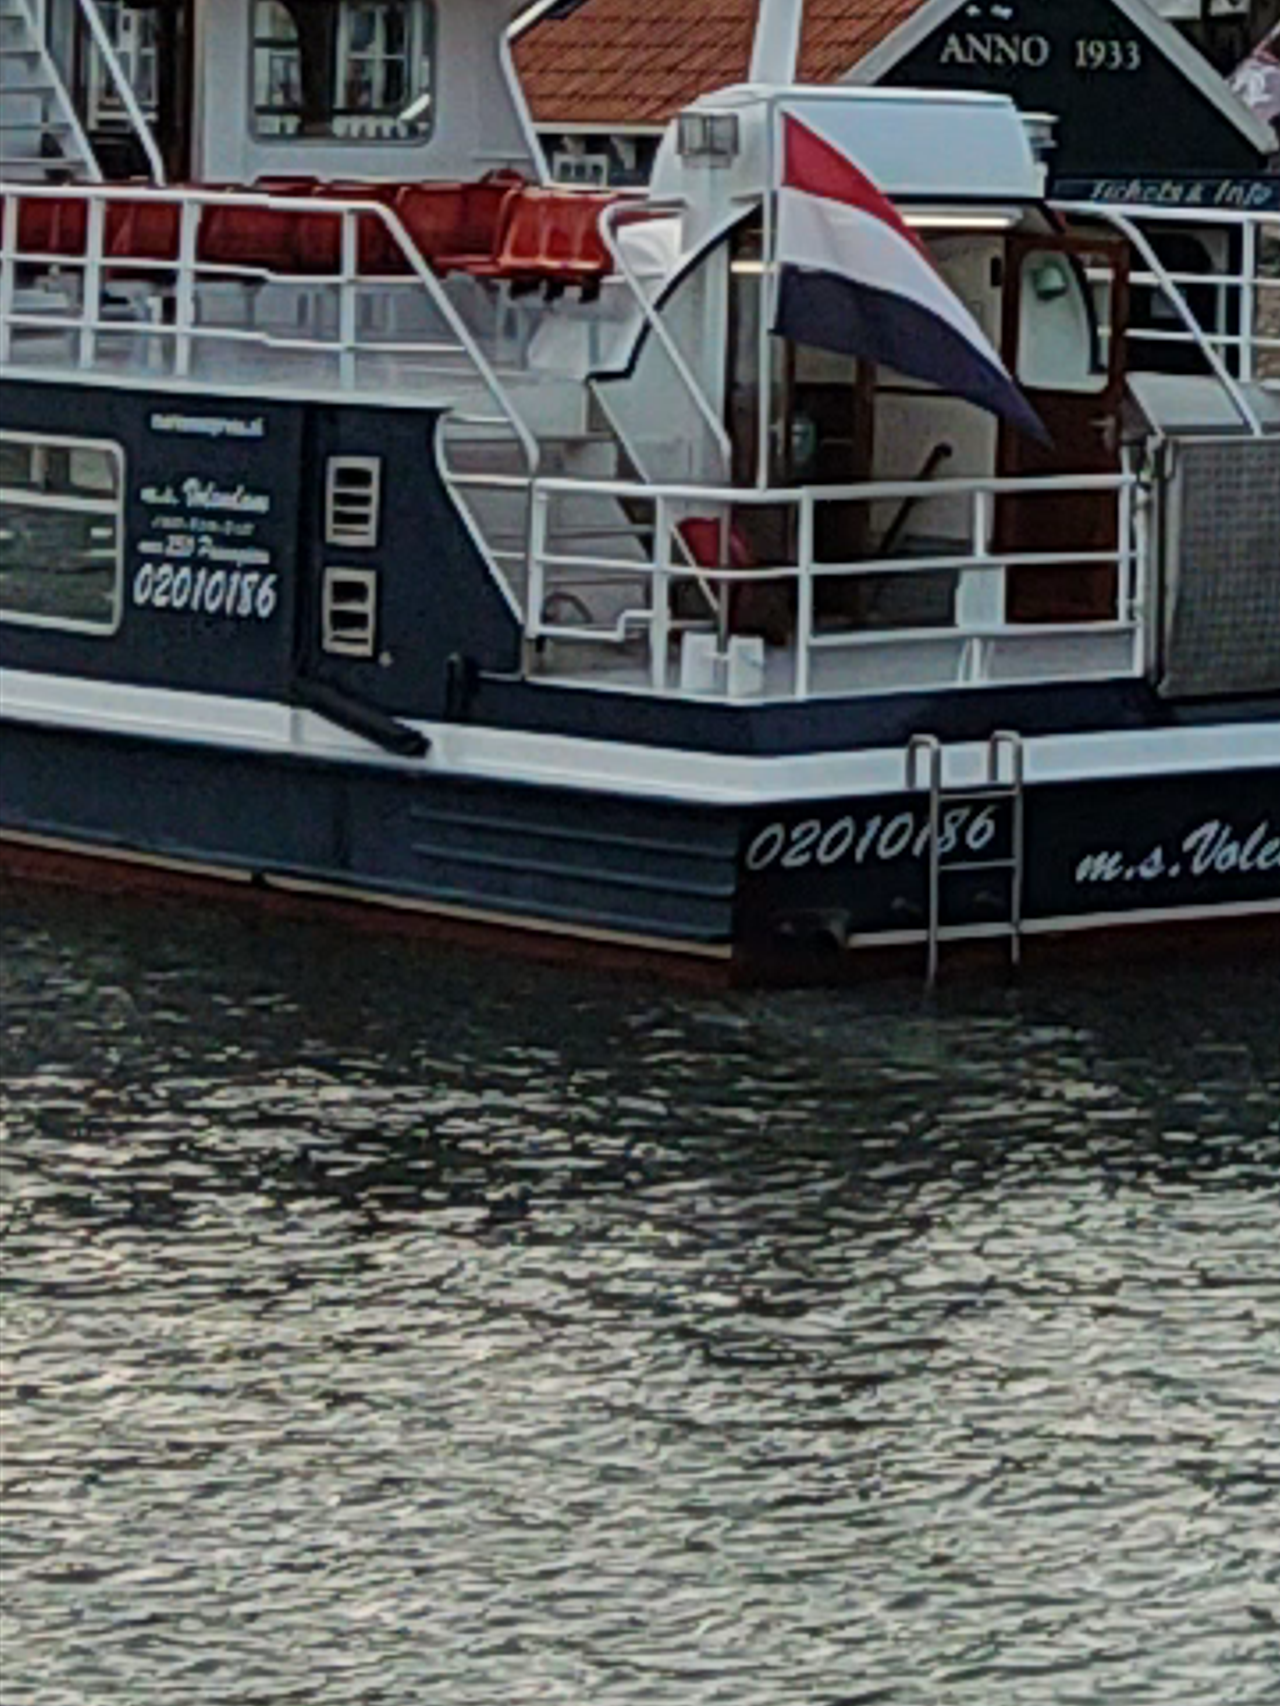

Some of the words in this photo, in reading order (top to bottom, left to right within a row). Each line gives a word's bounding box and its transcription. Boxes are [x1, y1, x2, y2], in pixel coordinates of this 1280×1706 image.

[939, 33, 1050, 68] ANNO
[1074, 39, 1142, 71] 1933
[133, 563, 278, 619] 02010186
